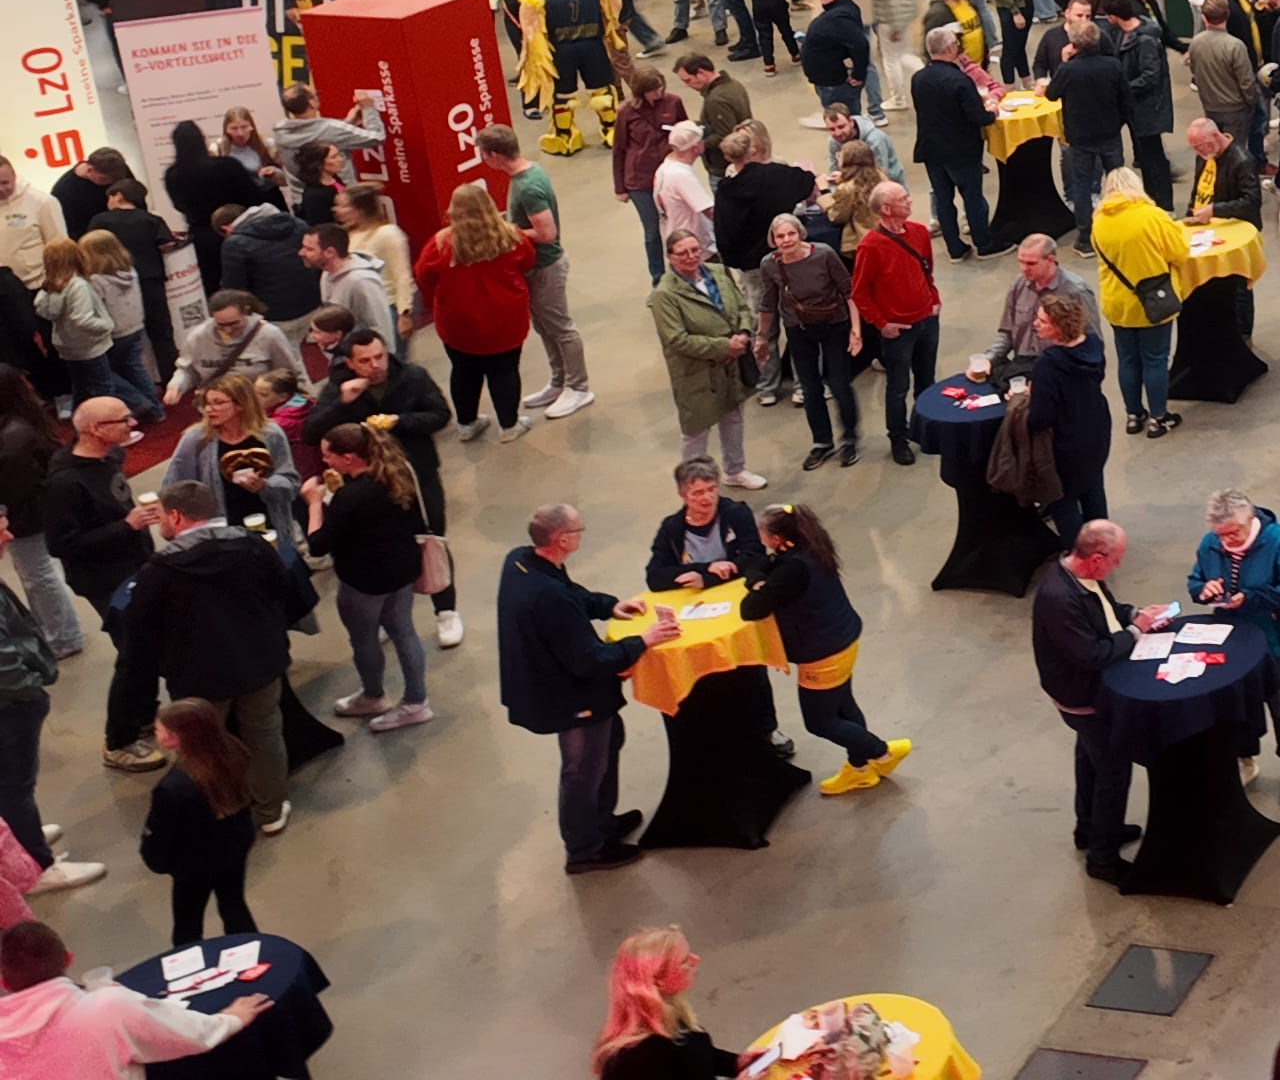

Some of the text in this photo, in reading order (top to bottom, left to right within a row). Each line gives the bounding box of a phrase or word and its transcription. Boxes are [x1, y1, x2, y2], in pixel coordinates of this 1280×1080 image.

[131, 33, 258, 59] KOMMEN SIE IN DIE
[134, 49, 245, 73] S-VORTEILSWELT!
[470, 38, 493, 112] Sparkasse
[21, 47, 75, 118] LzO
[79, 58, 95, 106] meine
[377, 60, 411, 183] meine Sparkasse
